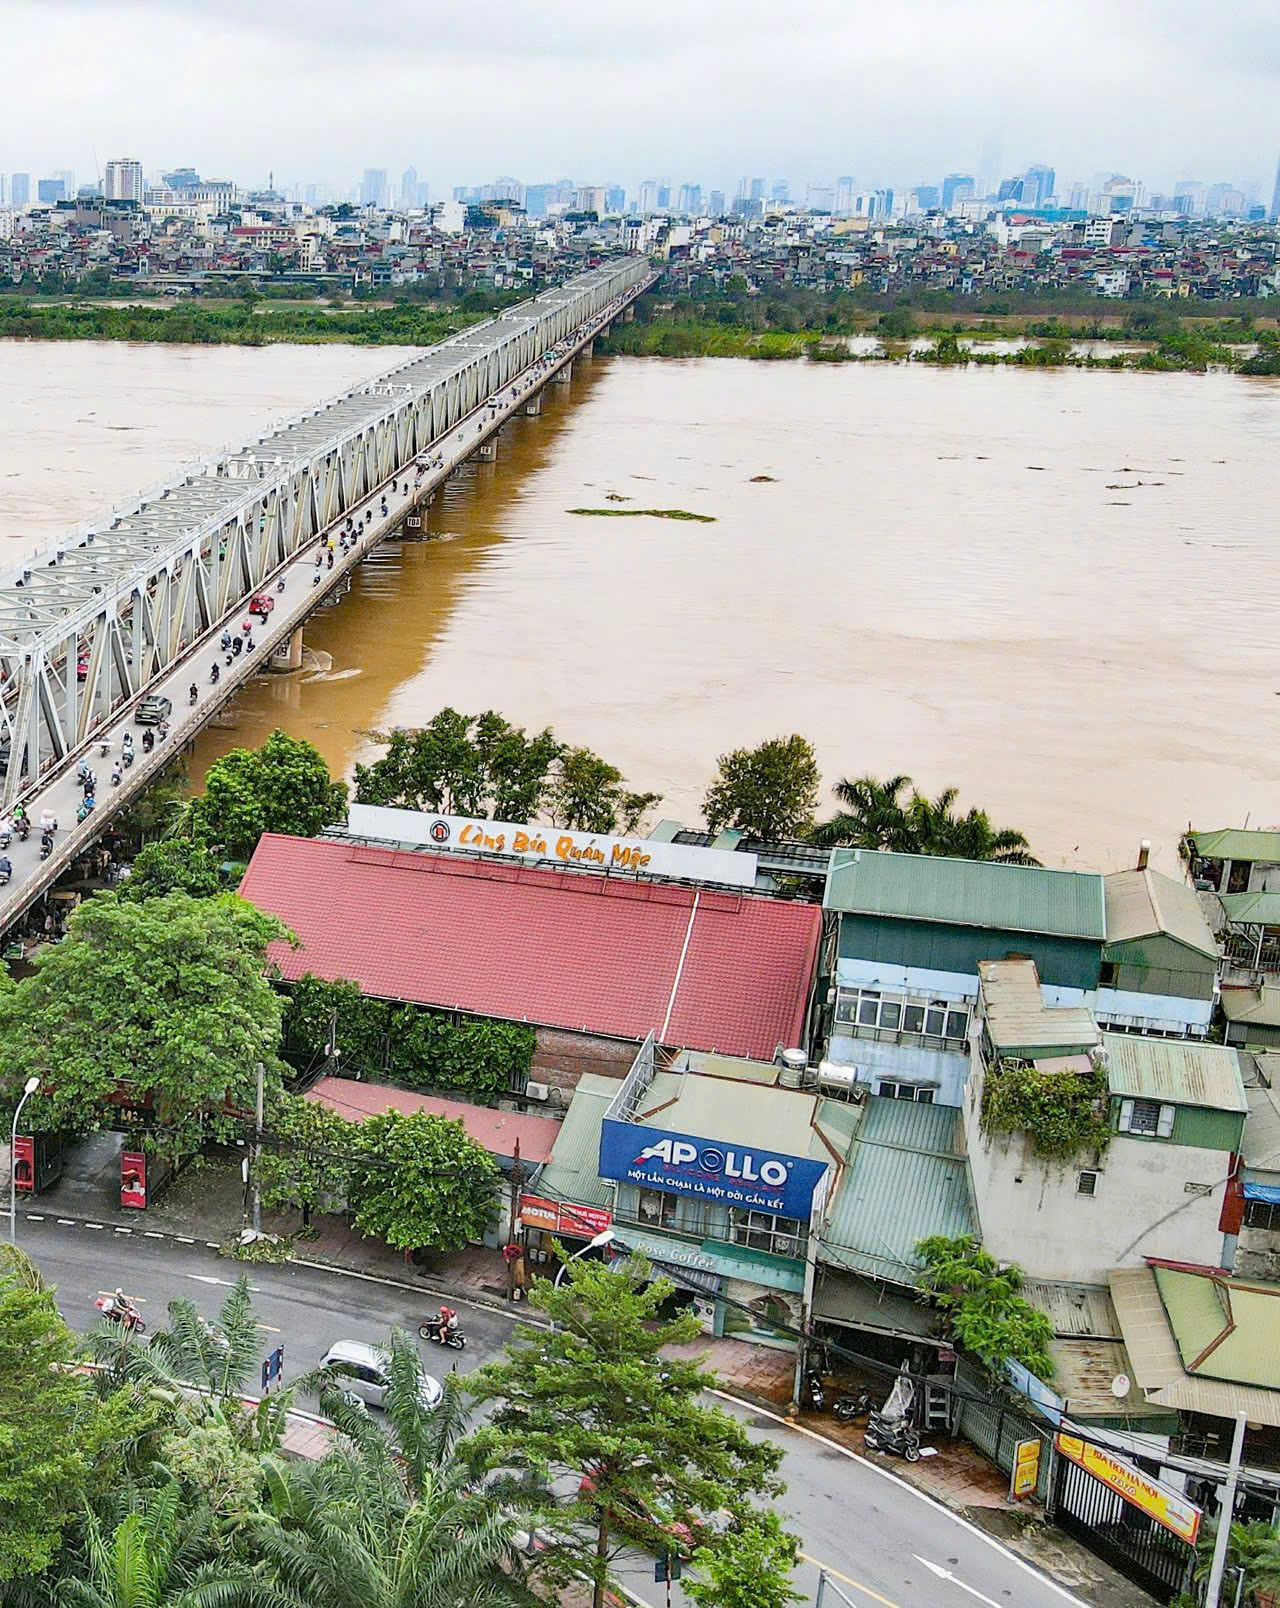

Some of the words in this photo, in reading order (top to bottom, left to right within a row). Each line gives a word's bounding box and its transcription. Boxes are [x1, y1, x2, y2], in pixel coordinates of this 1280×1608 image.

[458, 824, 505, 851] Làng
[556, 835, 605, 864] Quán
[610, 843, 652, 870] Mộc
[632, 1138, 788, 1186] APOLLO
[627, 1170, 646, 1181] MỘT
[647, 1171, 664, 1184] LẦN
[665, 1178, 692, 1190] CHẠM
[694, 1183, 705, 1193] LÀ
[706, 1186, 726, 1199] MỘT
[727, 1189, 743, 1201] ĐỜI
[745, 1193, 766, 1205] GẮN
[767, 1197, 785, 1210] KẾT
[521, 1206, 557, 1220] MOTUL
[670, 1249, 713, 1268] Coffee
